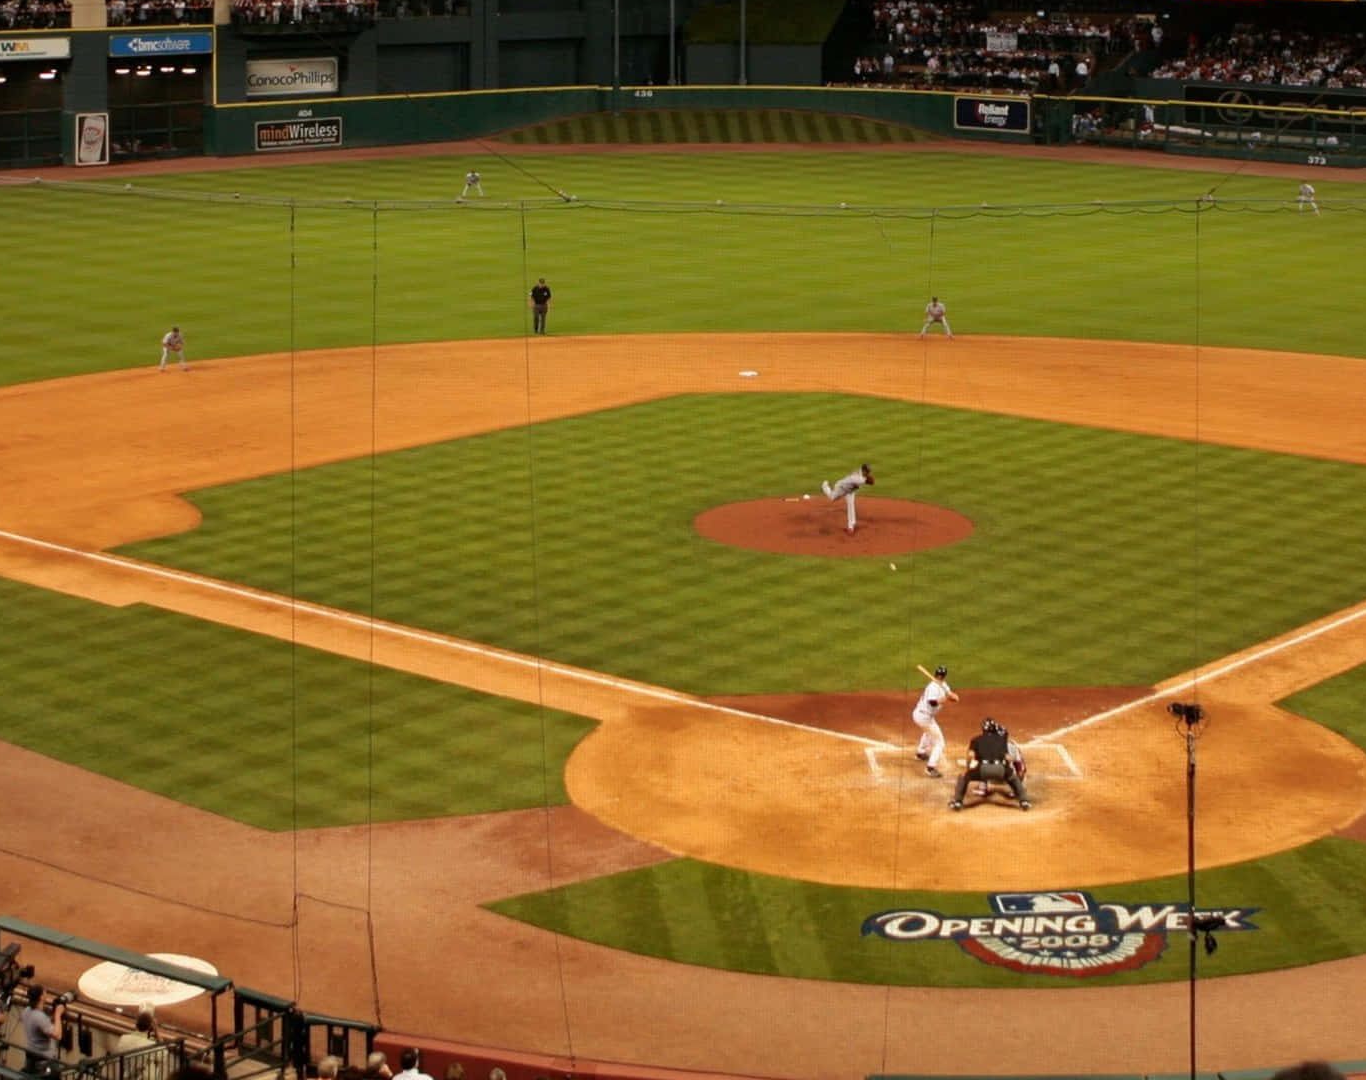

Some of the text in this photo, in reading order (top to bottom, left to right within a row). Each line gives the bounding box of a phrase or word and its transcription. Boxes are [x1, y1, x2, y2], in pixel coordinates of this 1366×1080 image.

[0, 42, 30, 52] WM
[247, 69, 335, 88] ConocoPhillips
[979, 103, 1009, 115] Reliant
[984, 115, 1008, 126] Energy
[259, 123, 338, 141] mindWireless
[1307, 156, 1327, 166] 373
[873, 909, 1096, 939] OPENING
[1019, 934, 1111, 949] 2008
